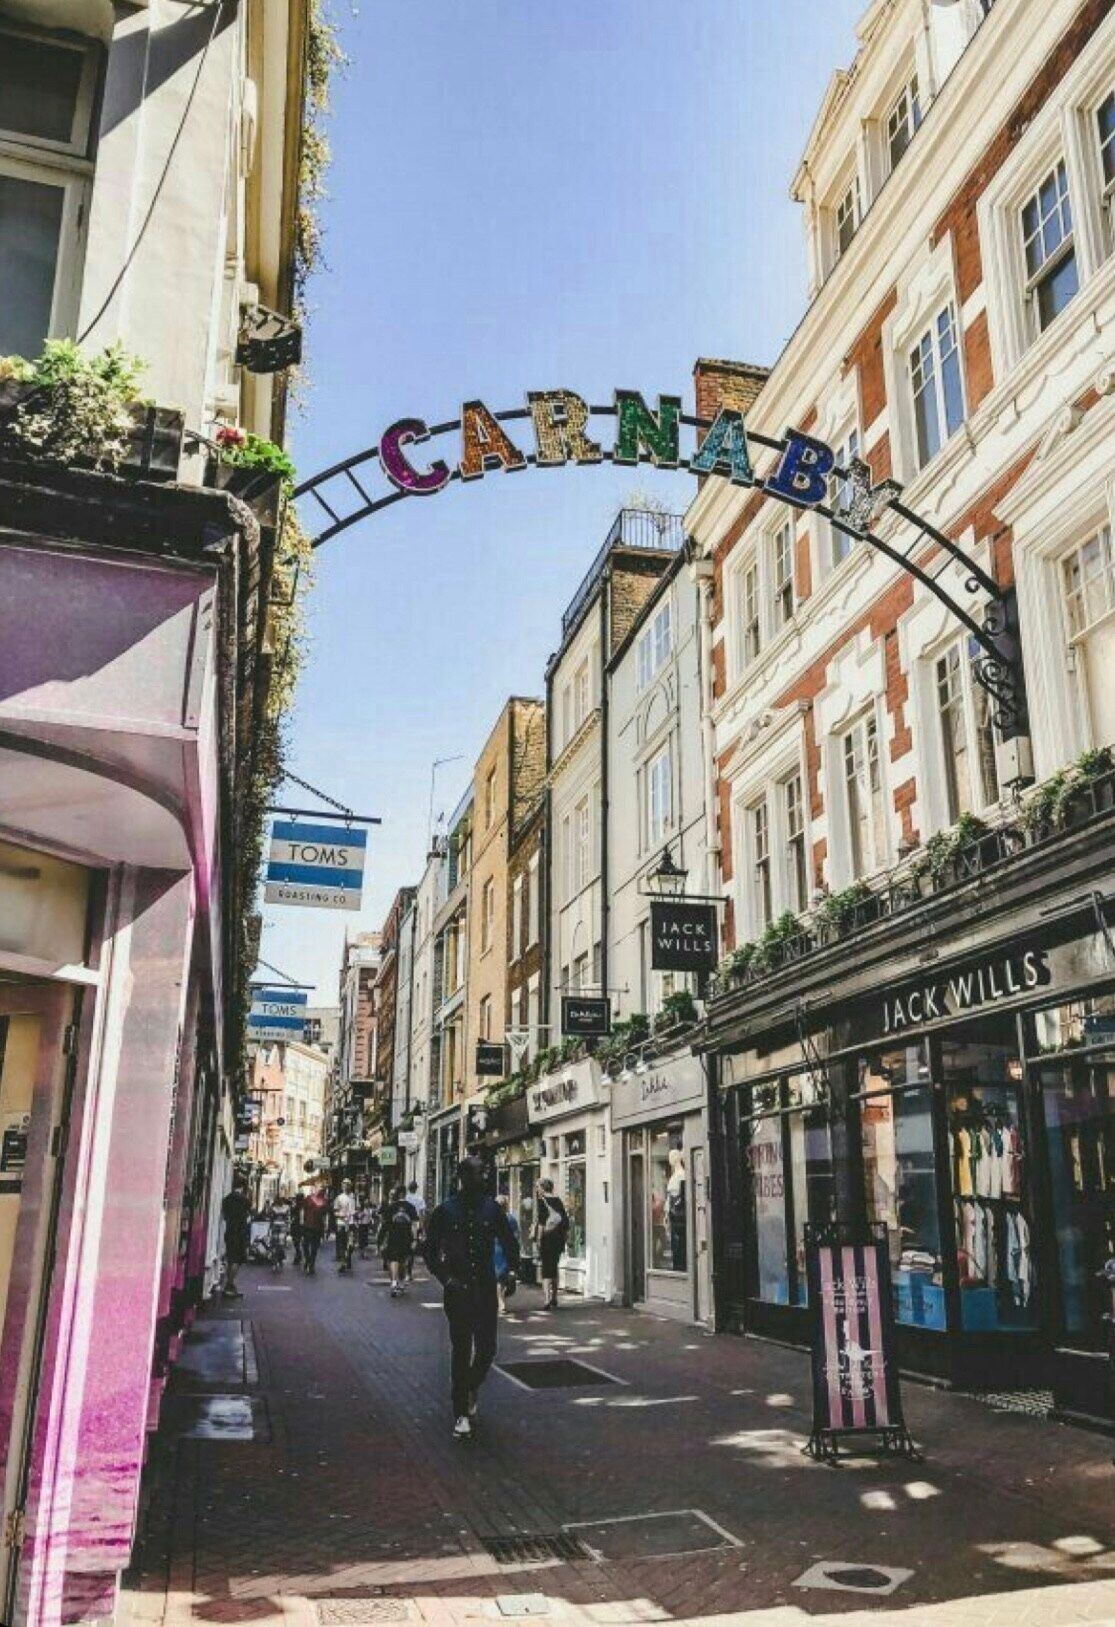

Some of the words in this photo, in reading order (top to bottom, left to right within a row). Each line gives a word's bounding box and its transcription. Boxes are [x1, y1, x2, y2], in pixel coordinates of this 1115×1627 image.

[378, 388, 904, 537] CARNABY
[288, 844, 348, 866] TOMS
[278, 889, 329, 903] ROASTING
[662, 921, 705, 935] JACK
[658, 937, 712, 952] WILLS
[883, 985, 940, 1033] JACK
[950, 951, 1038, 1008] WILLS
[261, 1003, 297, 1016] TOMS
